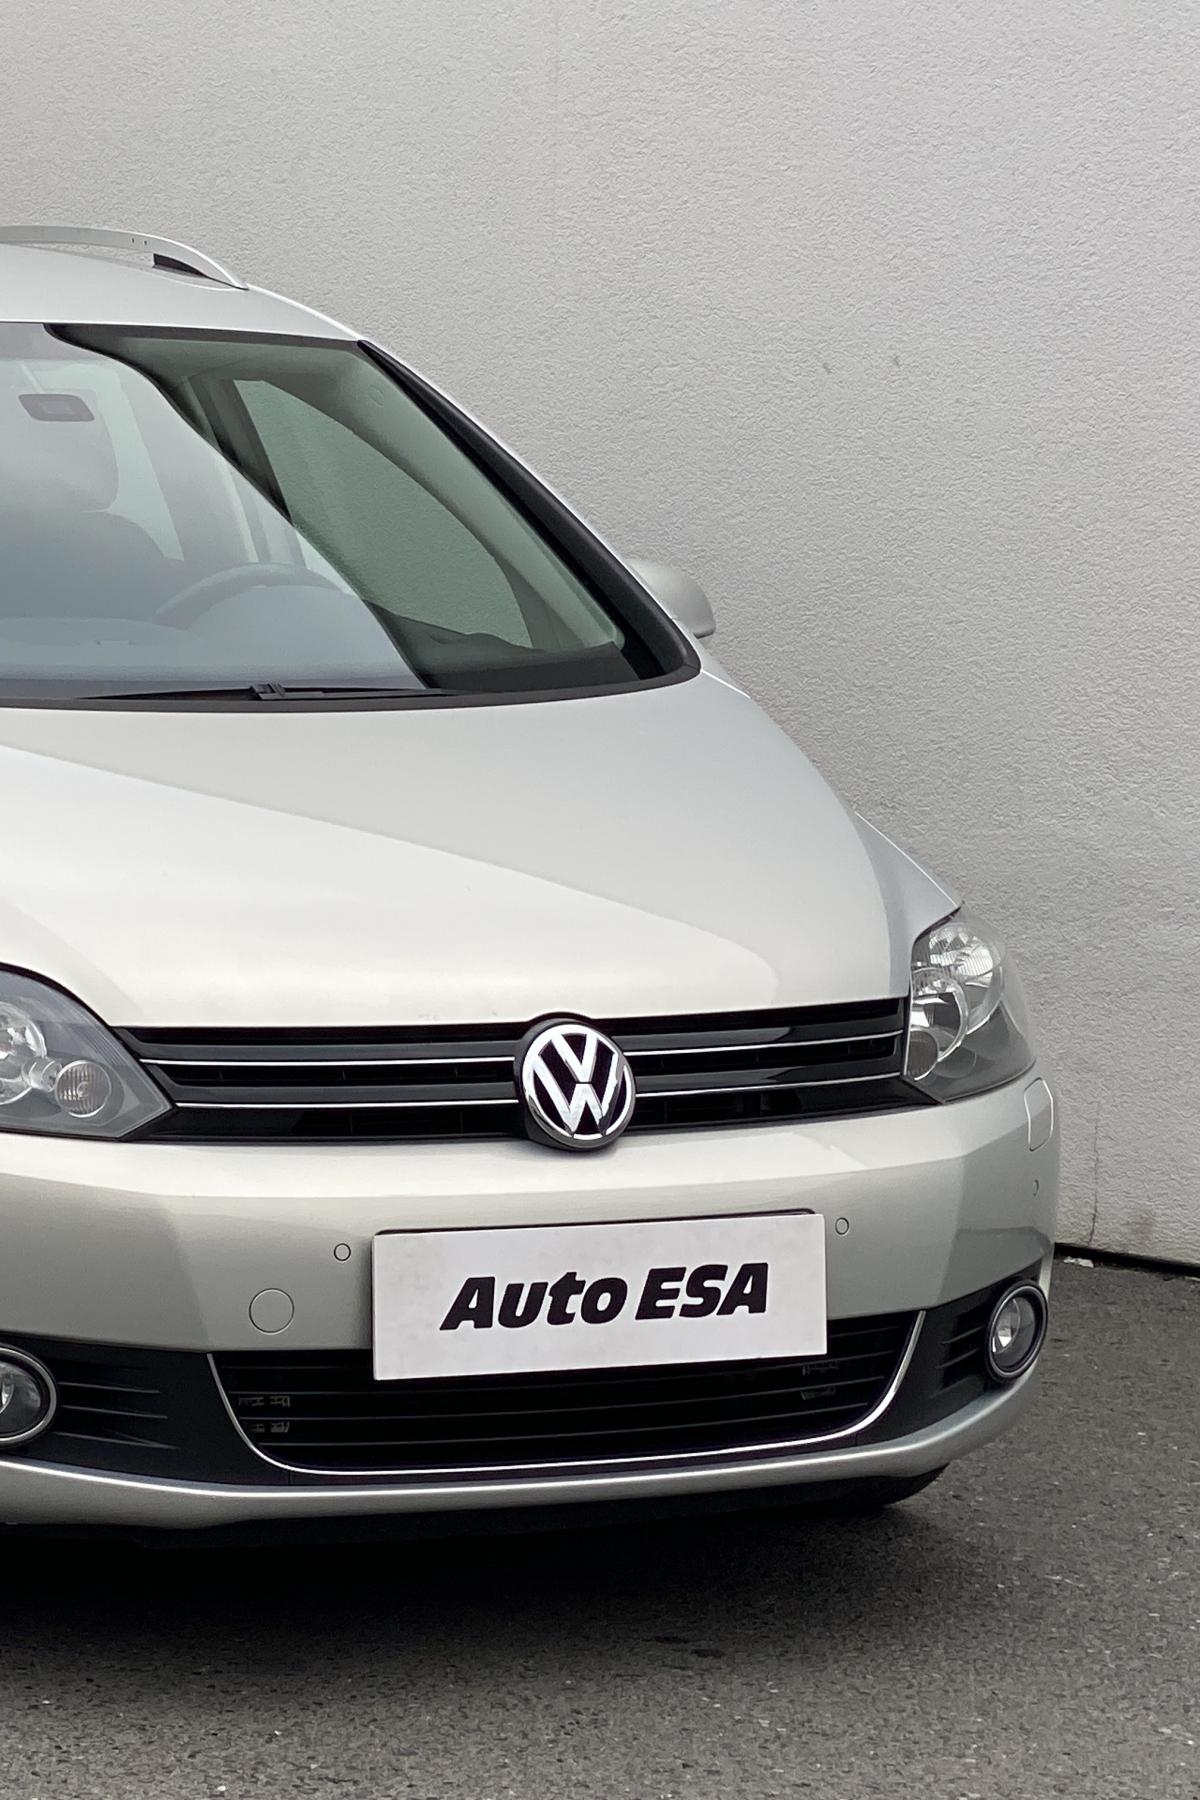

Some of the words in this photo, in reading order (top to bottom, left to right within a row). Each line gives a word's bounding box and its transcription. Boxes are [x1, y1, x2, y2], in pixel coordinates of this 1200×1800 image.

[524, 1024, 632, 1142] VW
[440, 1271, 628, 1331] Auto
[634, 1262, 769, 1321] ESA
